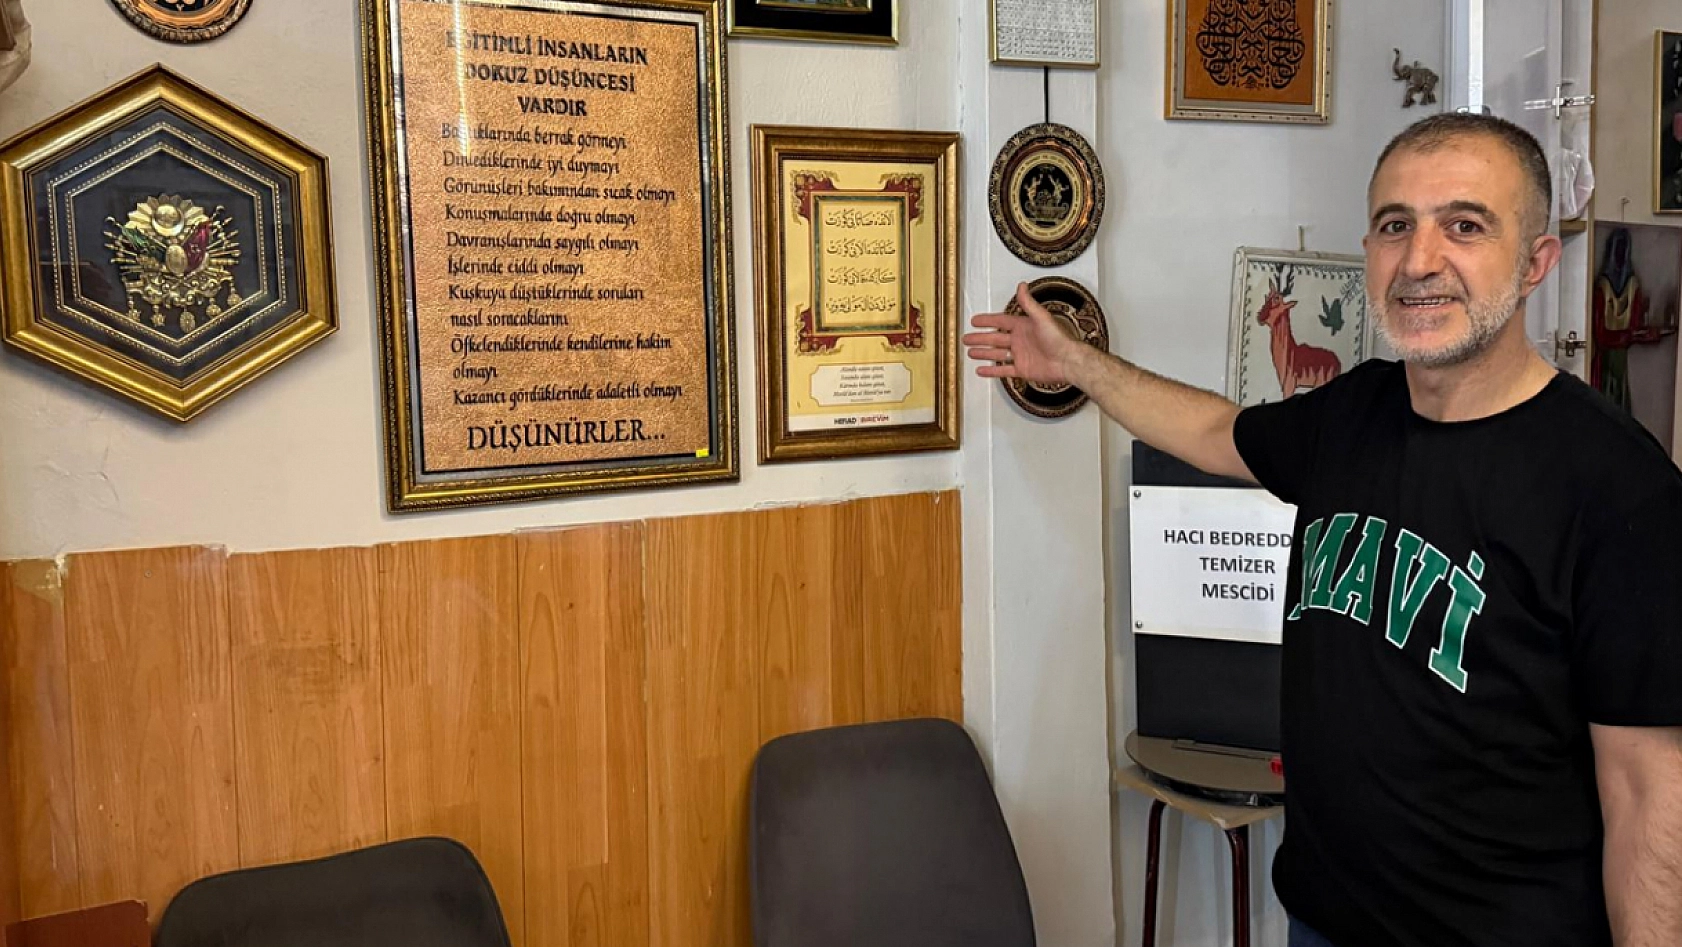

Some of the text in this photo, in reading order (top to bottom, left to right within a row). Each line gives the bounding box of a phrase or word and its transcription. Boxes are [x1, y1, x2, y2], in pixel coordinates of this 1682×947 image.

[537, 36, 648, 65] İNSANLARIN
[465, 63, 635, 92] DOKUZ DÜŞÜNCESİ
[517, 96, 588, 116] VARDIR
[441, 123, 627, 155] Baıklarında berrak görmeyi
[547, 155, 564, 177] iyi
[567, 155, 620, 179] duymayı
[444, 177, 675, 206] Görünüşleri bakımından sıcak olmayı
[445, 204, 637, 231] Konuşmalarında doğru olmayı
[446, 230, 639, 257] Davranışlarında saygılı olmayı
[448, 254, 584, 281] İşlerinde ciddi olmayı
[449, 283, 644, 306] Kuşkuya düştüklerinde soruları
[450, 308, 569, 327] nasıl soracaklarını
[451, 333, 672, 359] Öfkelendiklerinde kendilerine hakim
[453, 362, 498, 386] olmayı
[453, 381, 683, 410] Kazancı gördüklerinde adaletli olmayı
[467, 417, 666, 452] DÜŞÜNÜRLER...
[1163, 529, 1292, 549] HACI BEDREDD
[1199, 555, 1276, 575] TEMİZER
[1202, 582, 1275, 602] MESCİDİ
[1287, 513, 1487, 694] MAVİ
